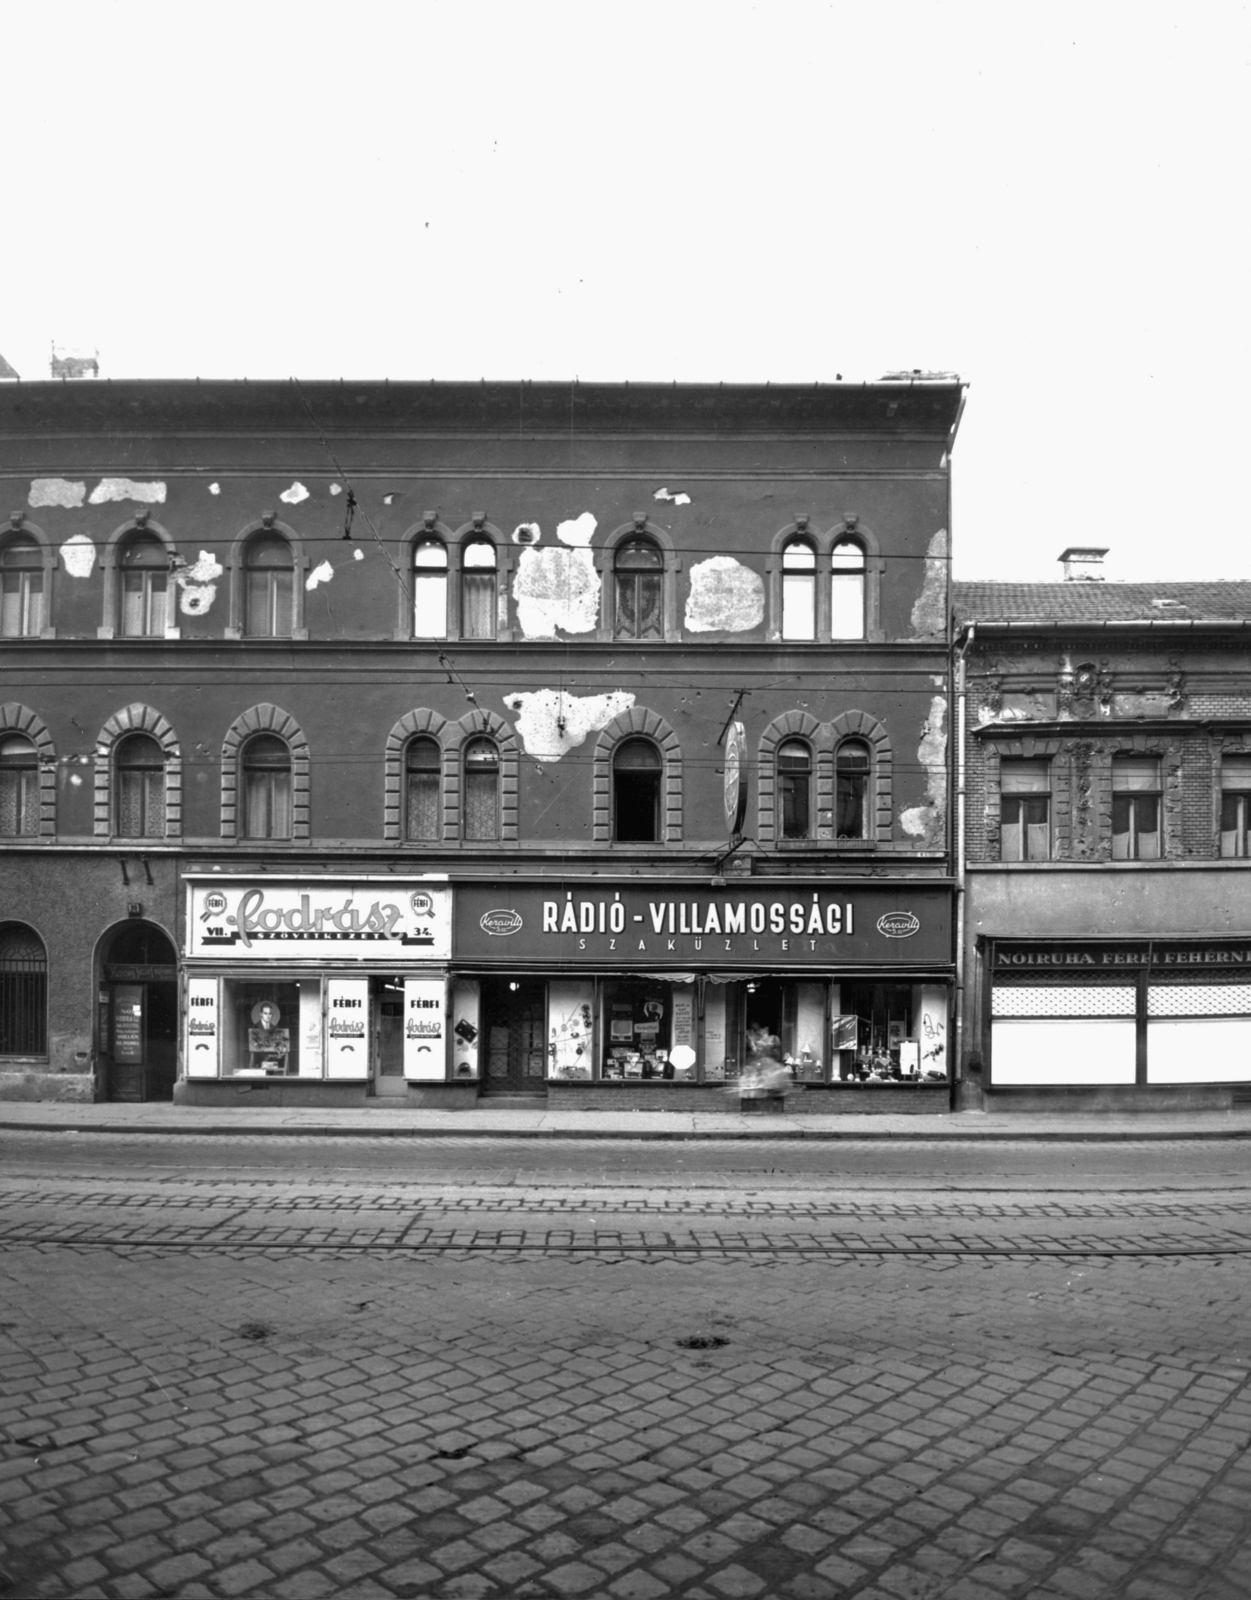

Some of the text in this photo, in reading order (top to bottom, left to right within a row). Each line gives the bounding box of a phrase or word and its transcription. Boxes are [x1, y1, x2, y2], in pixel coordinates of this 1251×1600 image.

[208, 897, 223, 908] FÉRFI
[413, 897, 429, 908] FÉRFI
[226, 889, 404, 948] fodrász
[481, 913, 521, 926] Keravill
[543, 892, 625, 933] RÁDIÓ
[649, 893, 853, 934] VILLAMOSSÁGI
[878, 916, 919, 929] Keravill
[206, 927, 228, 936] VII.
[257, 931, 380, 940] SZÖVETKEZET
[578, 937, 818, 951] SZAKÜZLET
[997, 951, 1095, 965] NŐIRUHA
[191, 996, 213, 1007] FÉRFI
[333, 996, 362, 1008] FÉRFI
[410, 997, 440, 1009] FÉRFI
[328, 1017, 364, 1039] fodrász
[405, 1017, 441, 1039] fodrász
